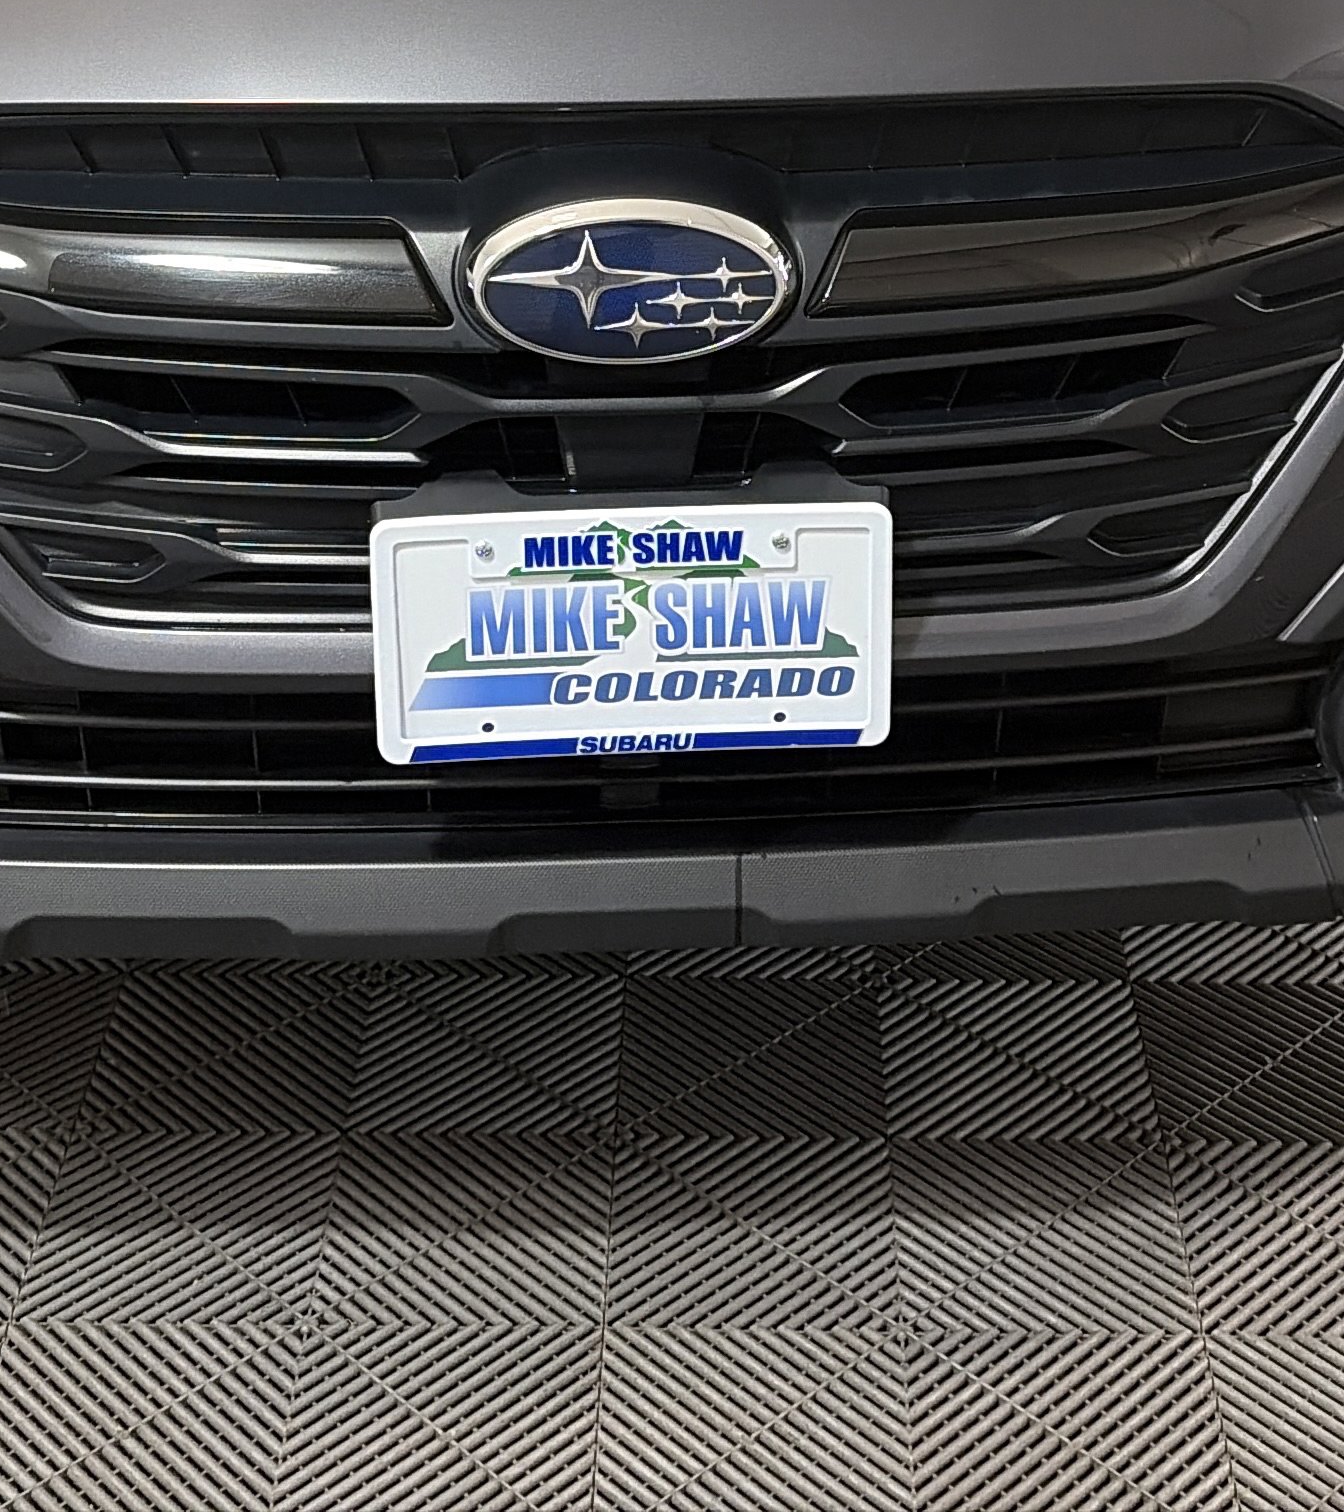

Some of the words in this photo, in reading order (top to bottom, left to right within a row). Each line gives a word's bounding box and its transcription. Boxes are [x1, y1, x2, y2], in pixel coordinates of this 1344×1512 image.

[524, 534, 615, 568] MIKE
[632, 531, 744, 564] SHAW
[469, 585, 621, 656] MIKE
[654, 580, 826, 651] SHAW
[553, 666, 855, 704] COLORADO
[579, 733, 693, 753] SUBARU
